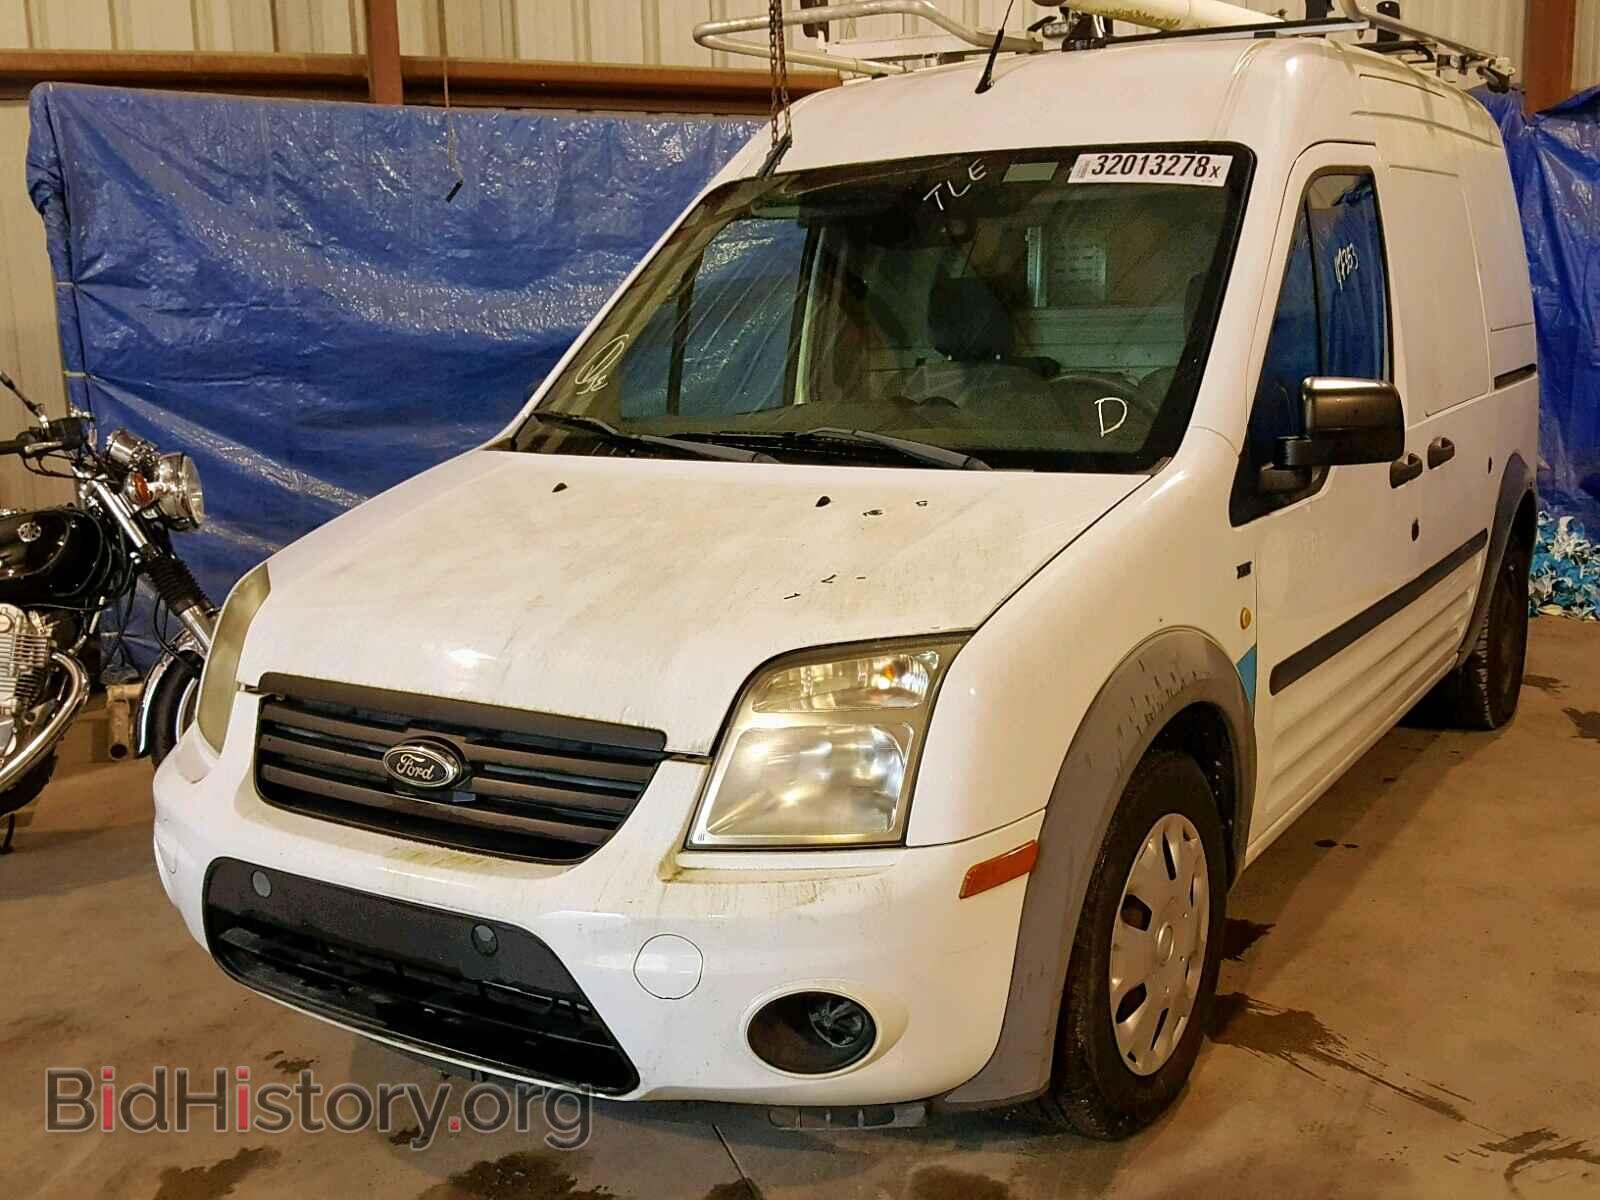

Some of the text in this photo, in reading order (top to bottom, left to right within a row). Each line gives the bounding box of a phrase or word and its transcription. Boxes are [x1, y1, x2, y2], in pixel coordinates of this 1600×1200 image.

[923, 158, 986, 211] TLE
[1094, 397, 1127, 437] D
[396, 753, 434, 780] Ford
